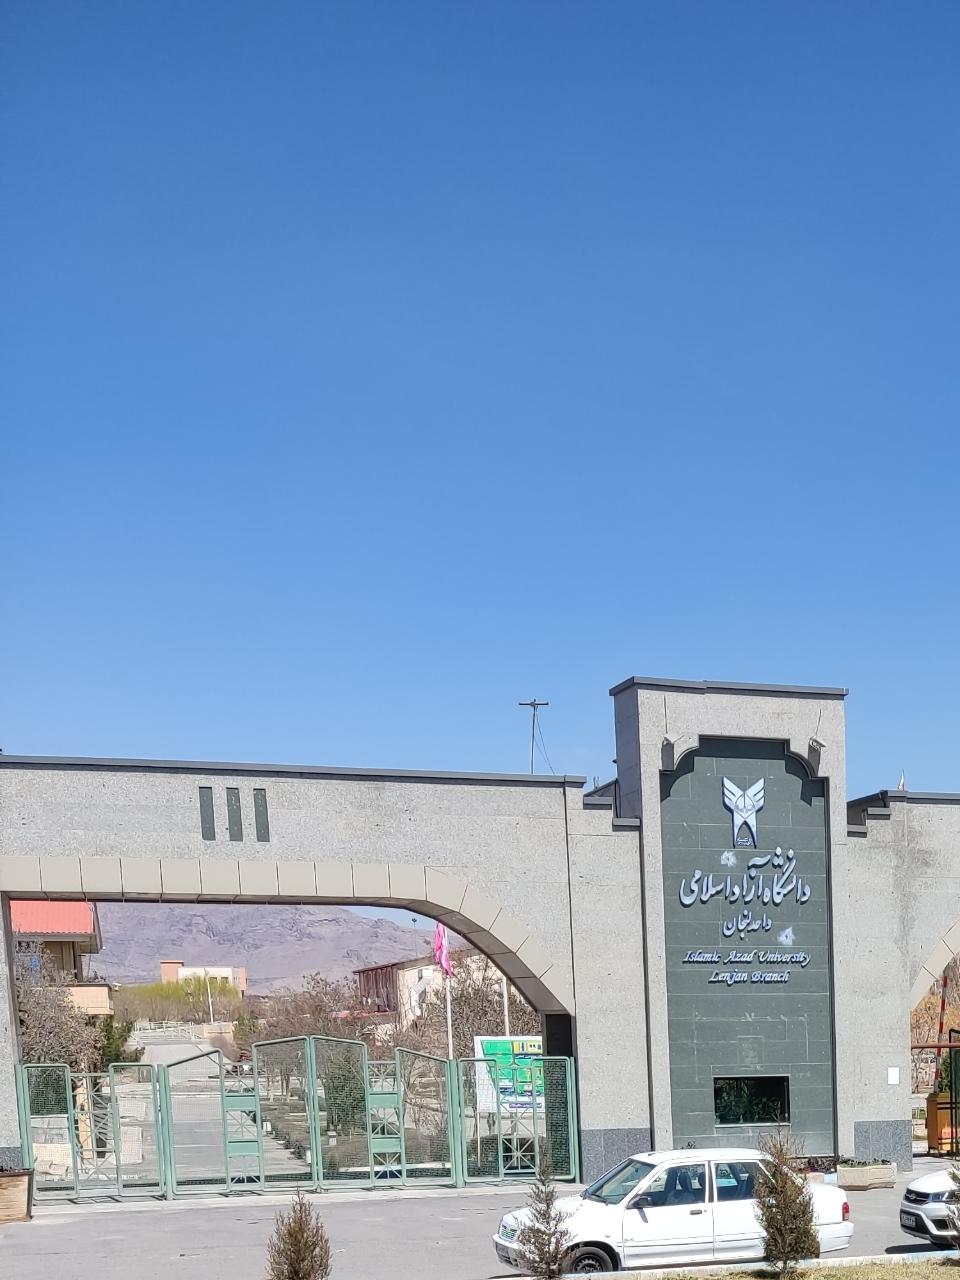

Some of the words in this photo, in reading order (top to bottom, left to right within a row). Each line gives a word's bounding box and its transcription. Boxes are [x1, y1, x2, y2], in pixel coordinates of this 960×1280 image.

[680, 869, 731, 907] اسلامی
[729, 855, 771, 904] آزاد
[763, 847, 811, 904] دانشگاه
[723, 909, 752, 938] لنجان
[683, 950, 721, 963] Islamic
[723, 950, 757, 964] Azad
[758, 950, 811, 967] University
[708, 968, 748, 985] Lenjan
[751, 969, 790, 983] Branch
